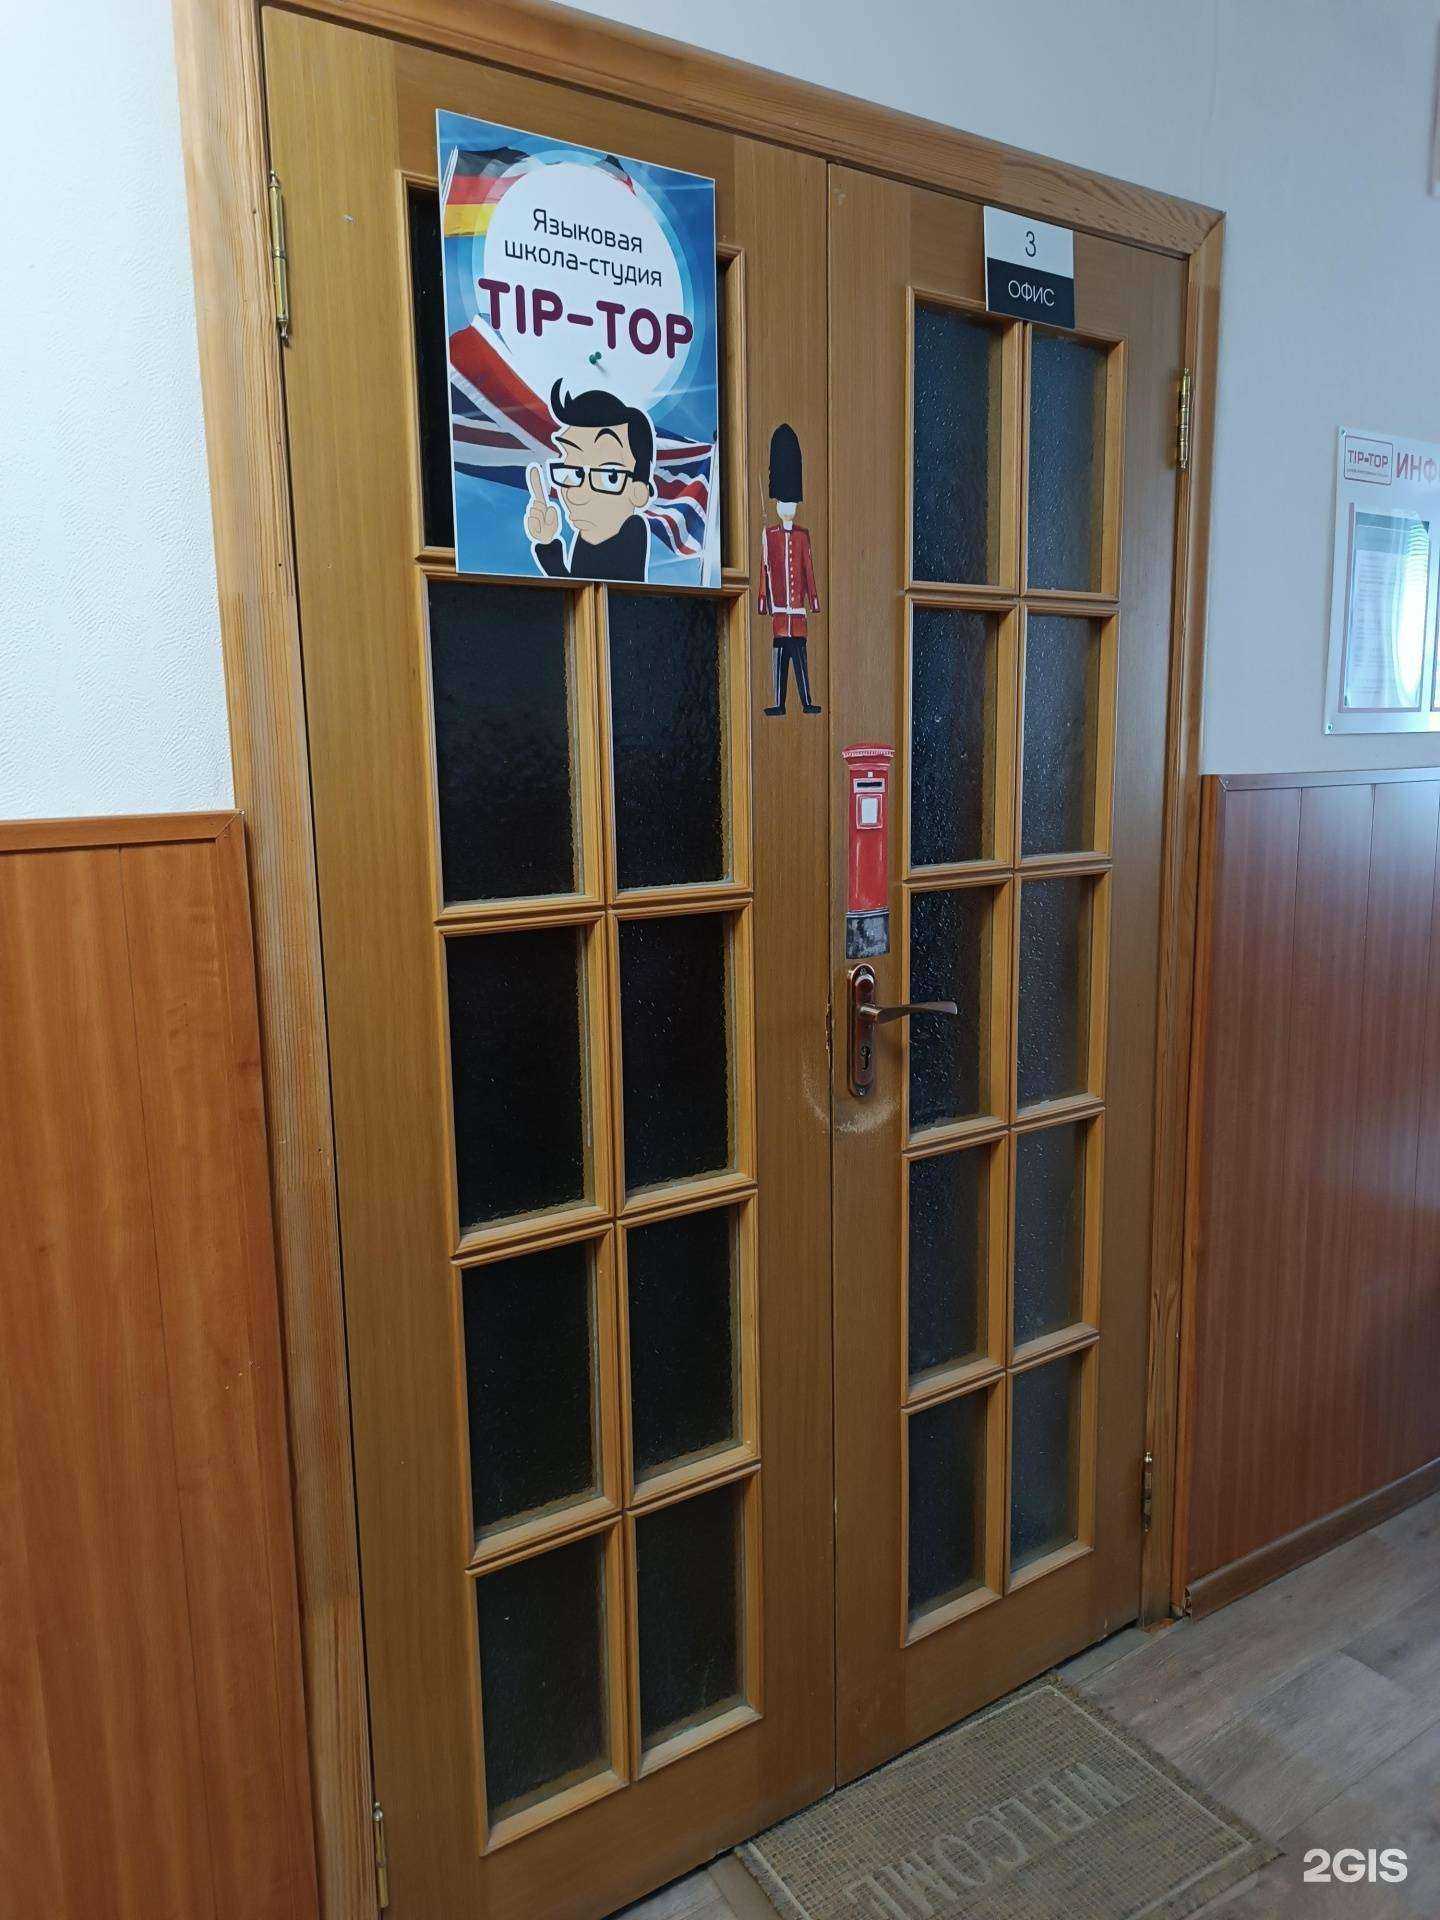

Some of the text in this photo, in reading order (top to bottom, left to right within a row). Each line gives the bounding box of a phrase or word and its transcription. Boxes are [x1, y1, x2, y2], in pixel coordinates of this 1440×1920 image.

[533, 208, 642, 253] Языковая
[1025, 230, 1037, 258] 3
[504, 240, 662, 287] школа-студия
[1008, 280, 1055, 307] ОФИС
[478, 278, 694, 359] TIP-TOP
[1347, 449, 1389, 469] TIP-TOP
[1396, 452, 1440, 486] ИНФ
